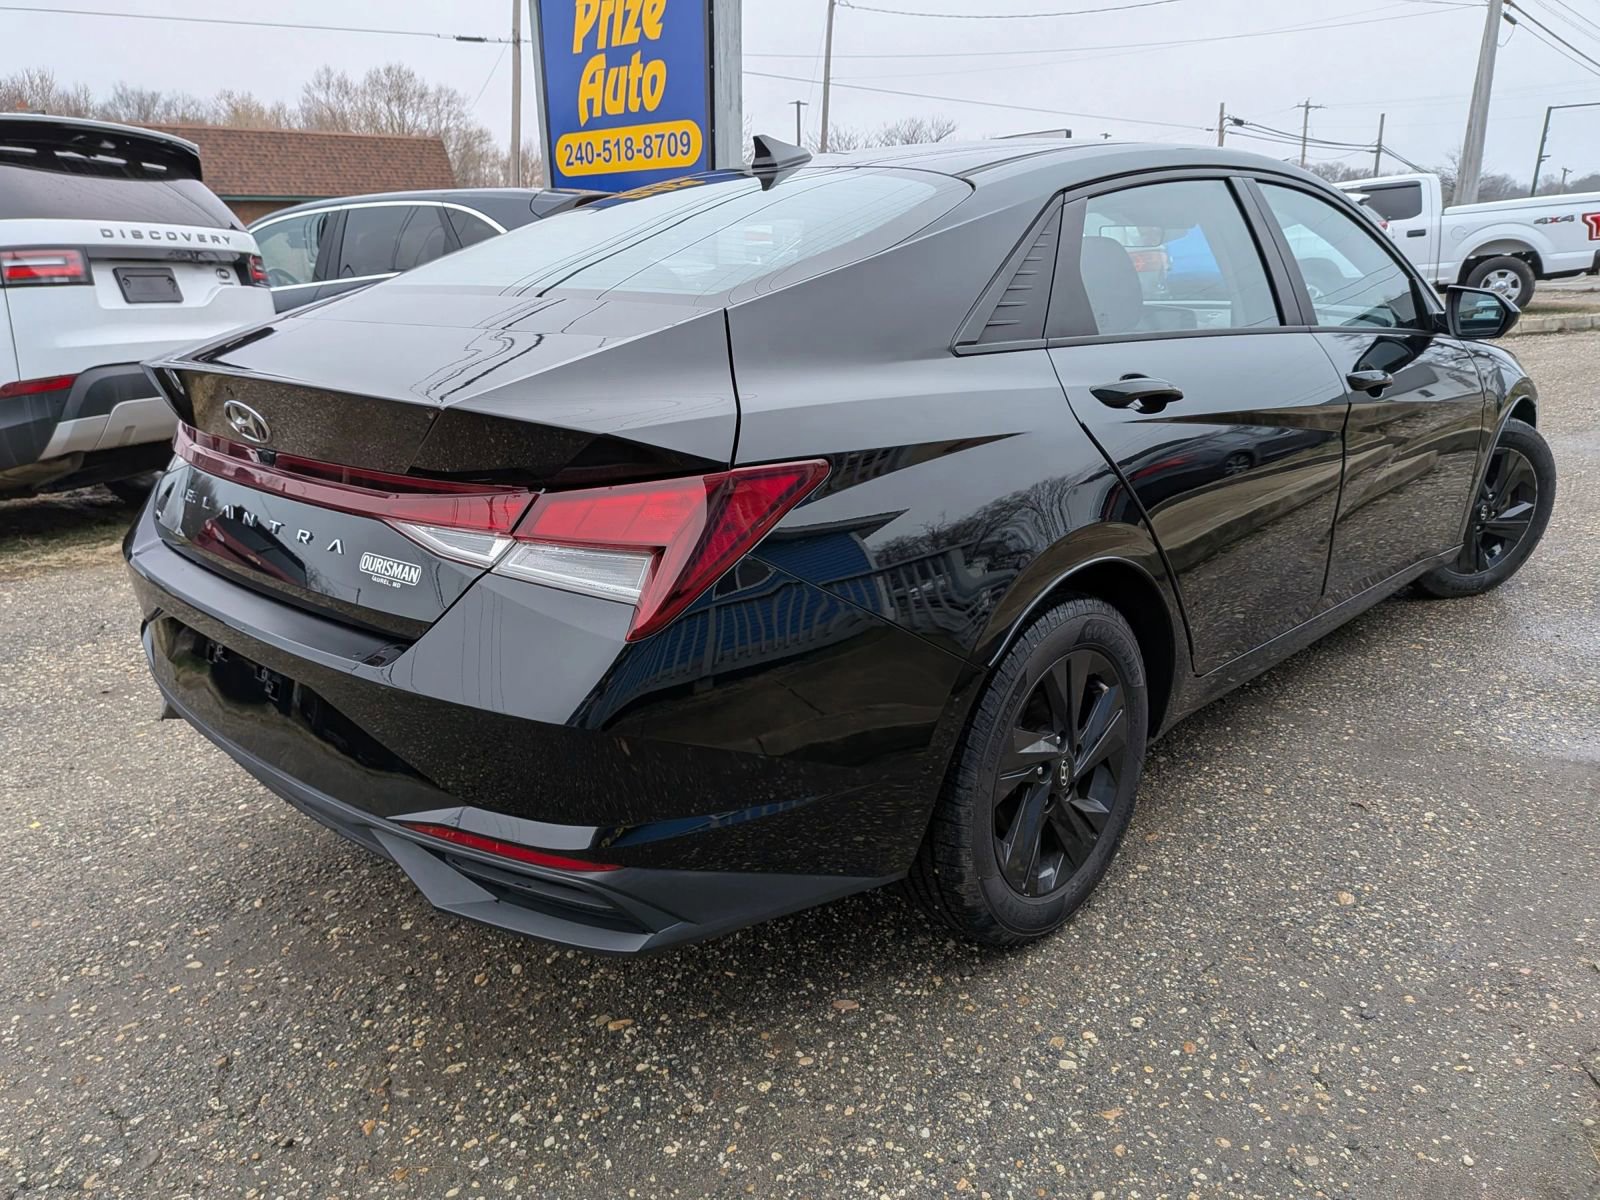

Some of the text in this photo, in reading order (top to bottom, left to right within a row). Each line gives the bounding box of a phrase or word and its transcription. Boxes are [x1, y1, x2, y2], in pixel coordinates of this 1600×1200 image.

[572, 0, 668, 54] Prize
[578, 50, 667, 127] Auto
[564, 131, 692, 167] 240-518-8709
[99, 228, 231, 245] DISCOVERY
[184, 488, 346, 555] ELANTRA
[361, 554, 420, 583] OURISMAN
